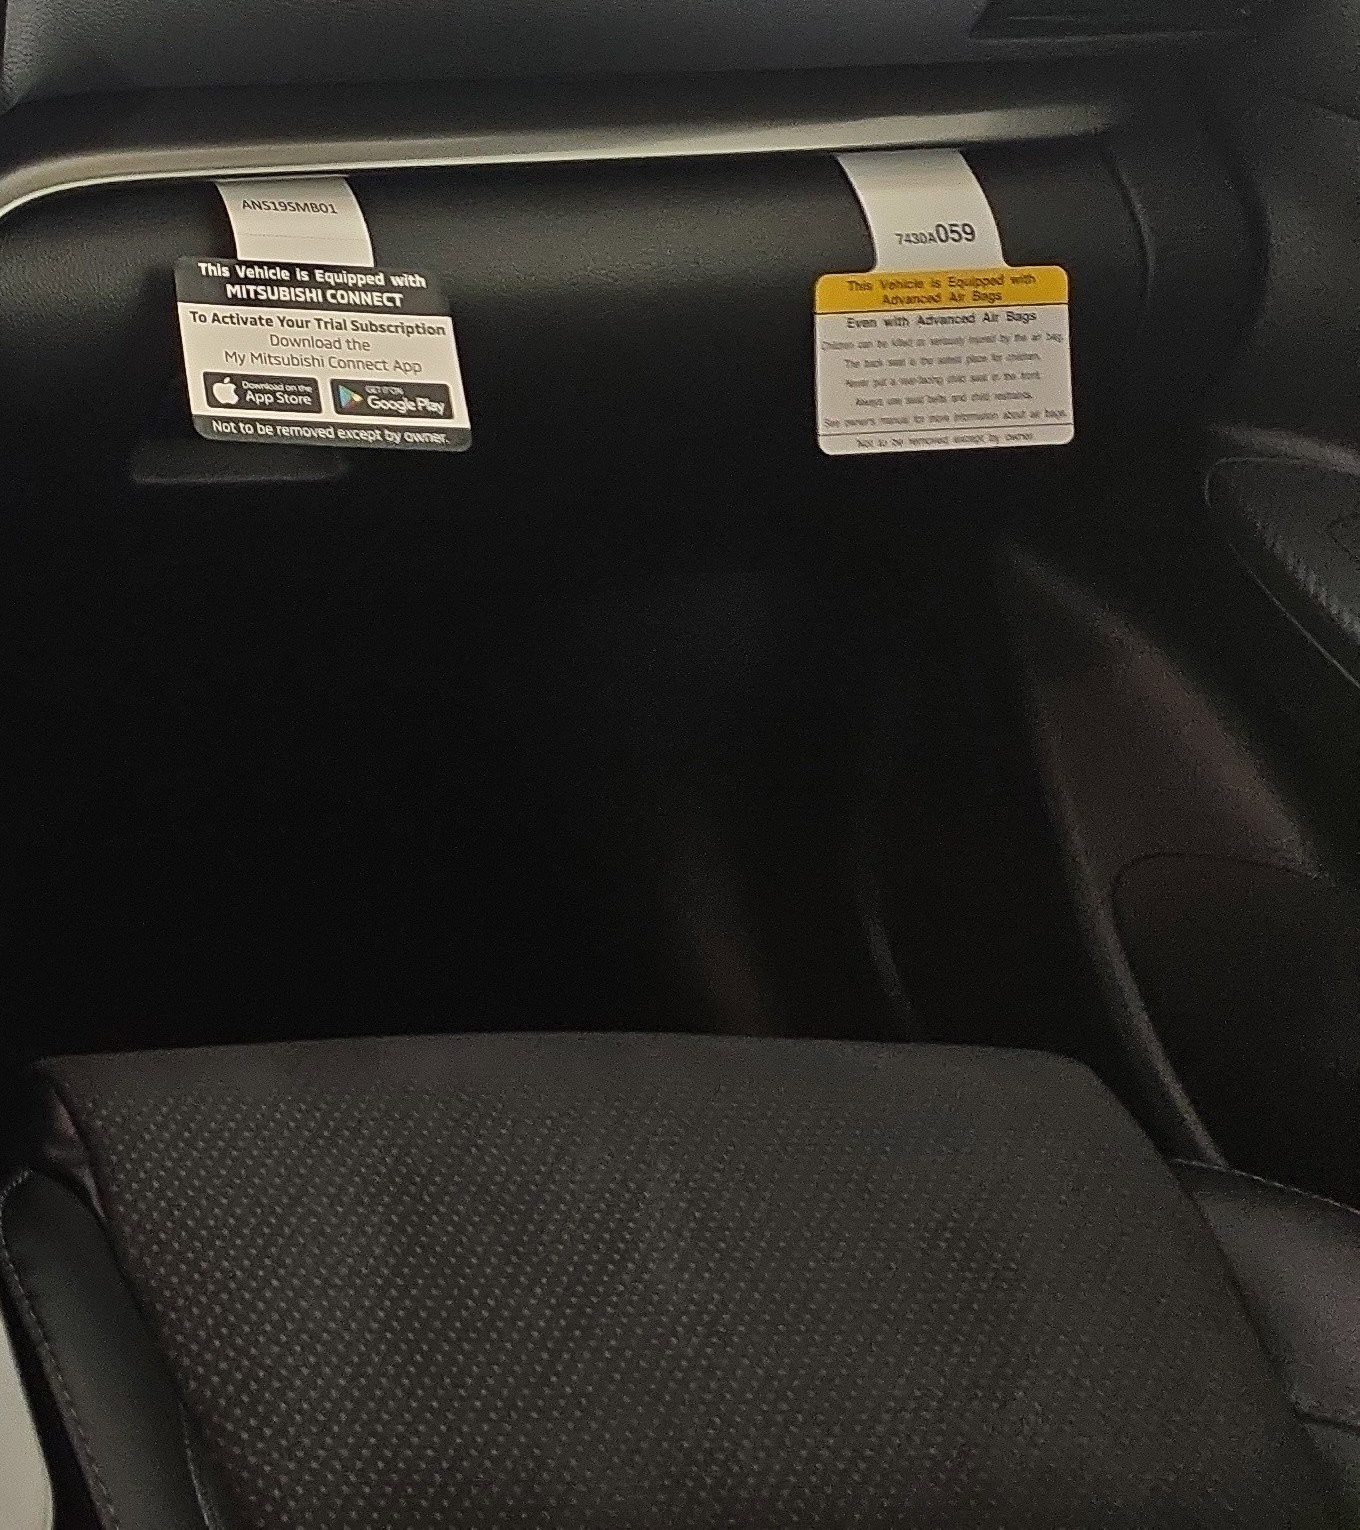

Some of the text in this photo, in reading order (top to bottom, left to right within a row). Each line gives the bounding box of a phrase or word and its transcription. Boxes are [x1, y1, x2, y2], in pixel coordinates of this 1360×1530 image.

[197, 262, 427, 290] This Vehicle is Equipped with
[846, 280, 872, 291] This
[880, 279, 924, 290] Vehicle
[948, 274, 1004, 288] Equipped
[226, 284, 404, 307] MITSUBISHI CONNECT
[972, 290, 1002, 304] Bags
[190, 310, 446, 338] To Activate Your Trial Subscription
[270, 334, 371, 351] Download the
[225, 350, 422, 375] My Mitsubishi Connect App
[246, 391, 312, 406] App Store
[366, 395, 445, 416] Google Play
[212, 419, 450, 444] Not to be removed except by owner.
